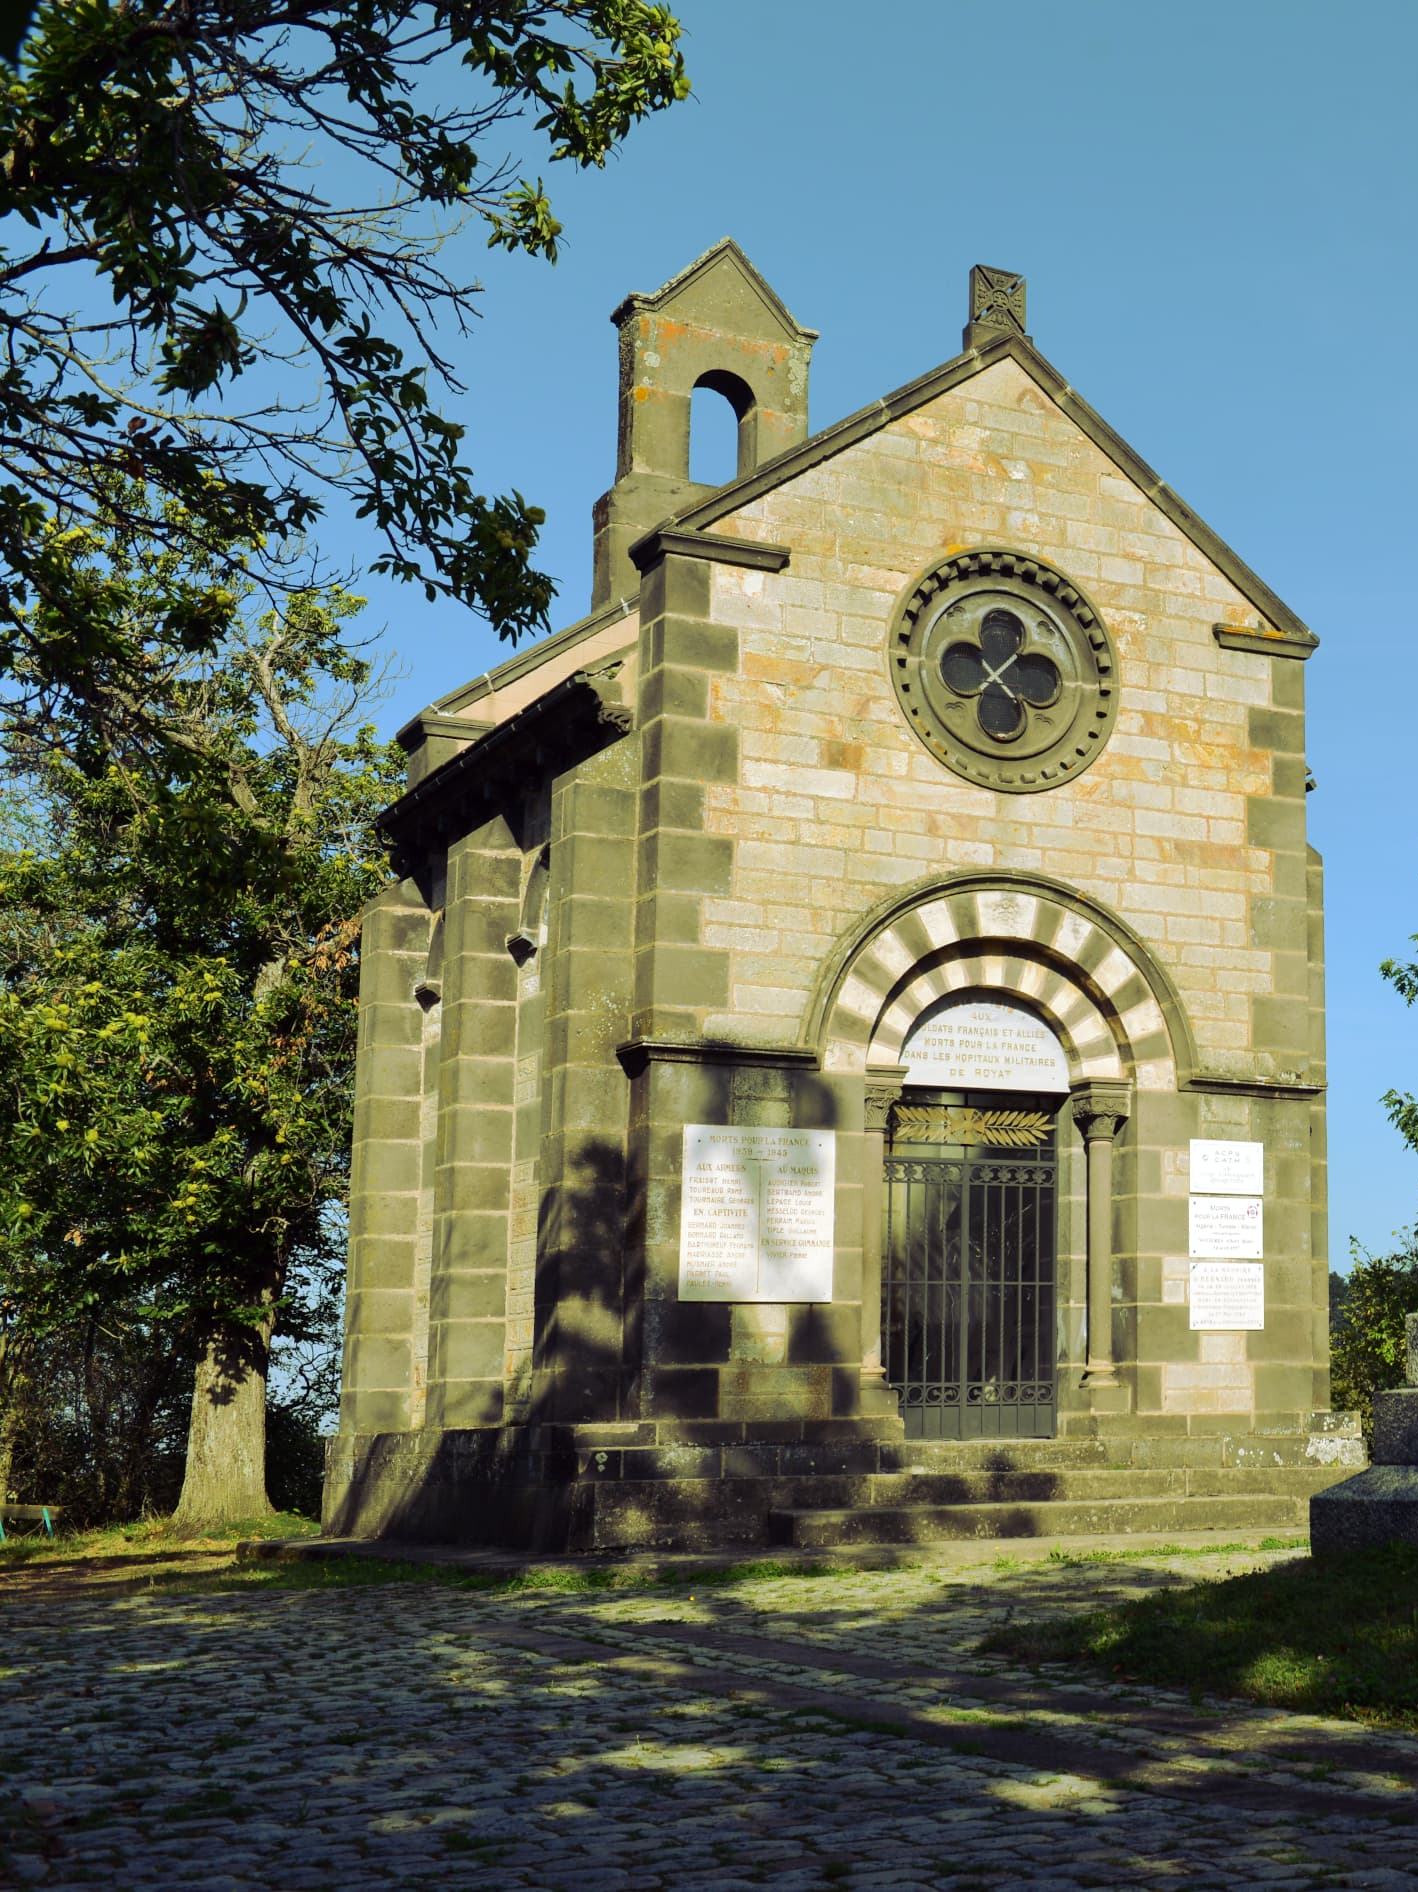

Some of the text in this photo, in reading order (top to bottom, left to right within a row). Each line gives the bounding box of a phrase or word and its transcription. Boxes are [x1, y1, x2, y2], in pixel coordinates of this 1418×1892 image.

[970, 1012, 992, 1021] AUX
[921, 1024, 954, 1034] OLDATS
[957, 1026, 998, 1037] FRANÇAIS
[1002, 1029, 1013, 1037] ET
[924, 1038, 1037, 1052] MORTS POUR LA FRANCE
[903, 1051, 928, 1060] DANS
[932, 1052, 950, 1061] LES
[1004, 1055, 1056, 1067] MILITAIRES
[949, 1068, 1012, 1079] DE ROYAT
[710, 1136, 738, 1144] MORTS
[741, 1136, 764, 1145] POUR
[778, 1138, 810, 1146] FRANCE
